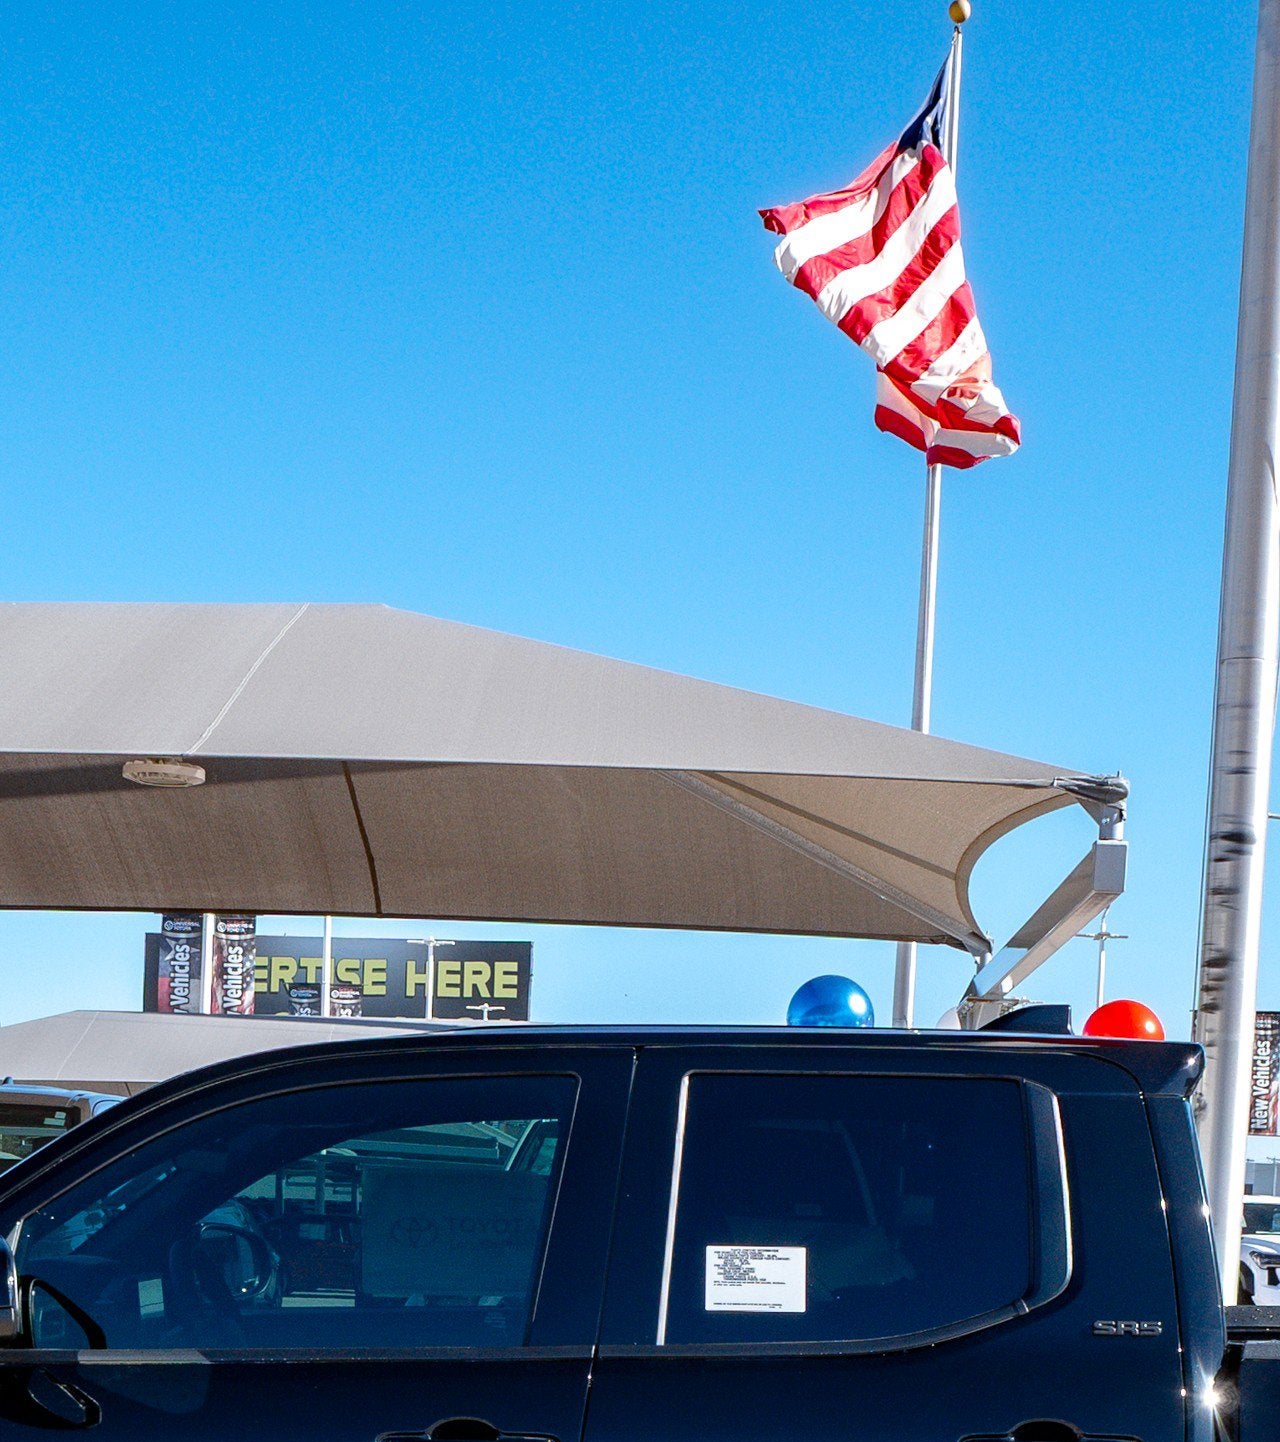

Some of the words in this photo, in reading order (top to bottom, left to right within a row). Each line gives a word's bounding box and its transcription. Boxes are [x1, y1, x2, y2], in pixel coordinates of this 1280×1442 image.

[169, 944, 190, 1006] Vehicles
[223, 946, 244, 1008] Vehicles
[405, 959, 519, 999] HERE
[1252, 1040, 1272, 1098] Vehicles
[1250, 1099, 1269, 1129] New
